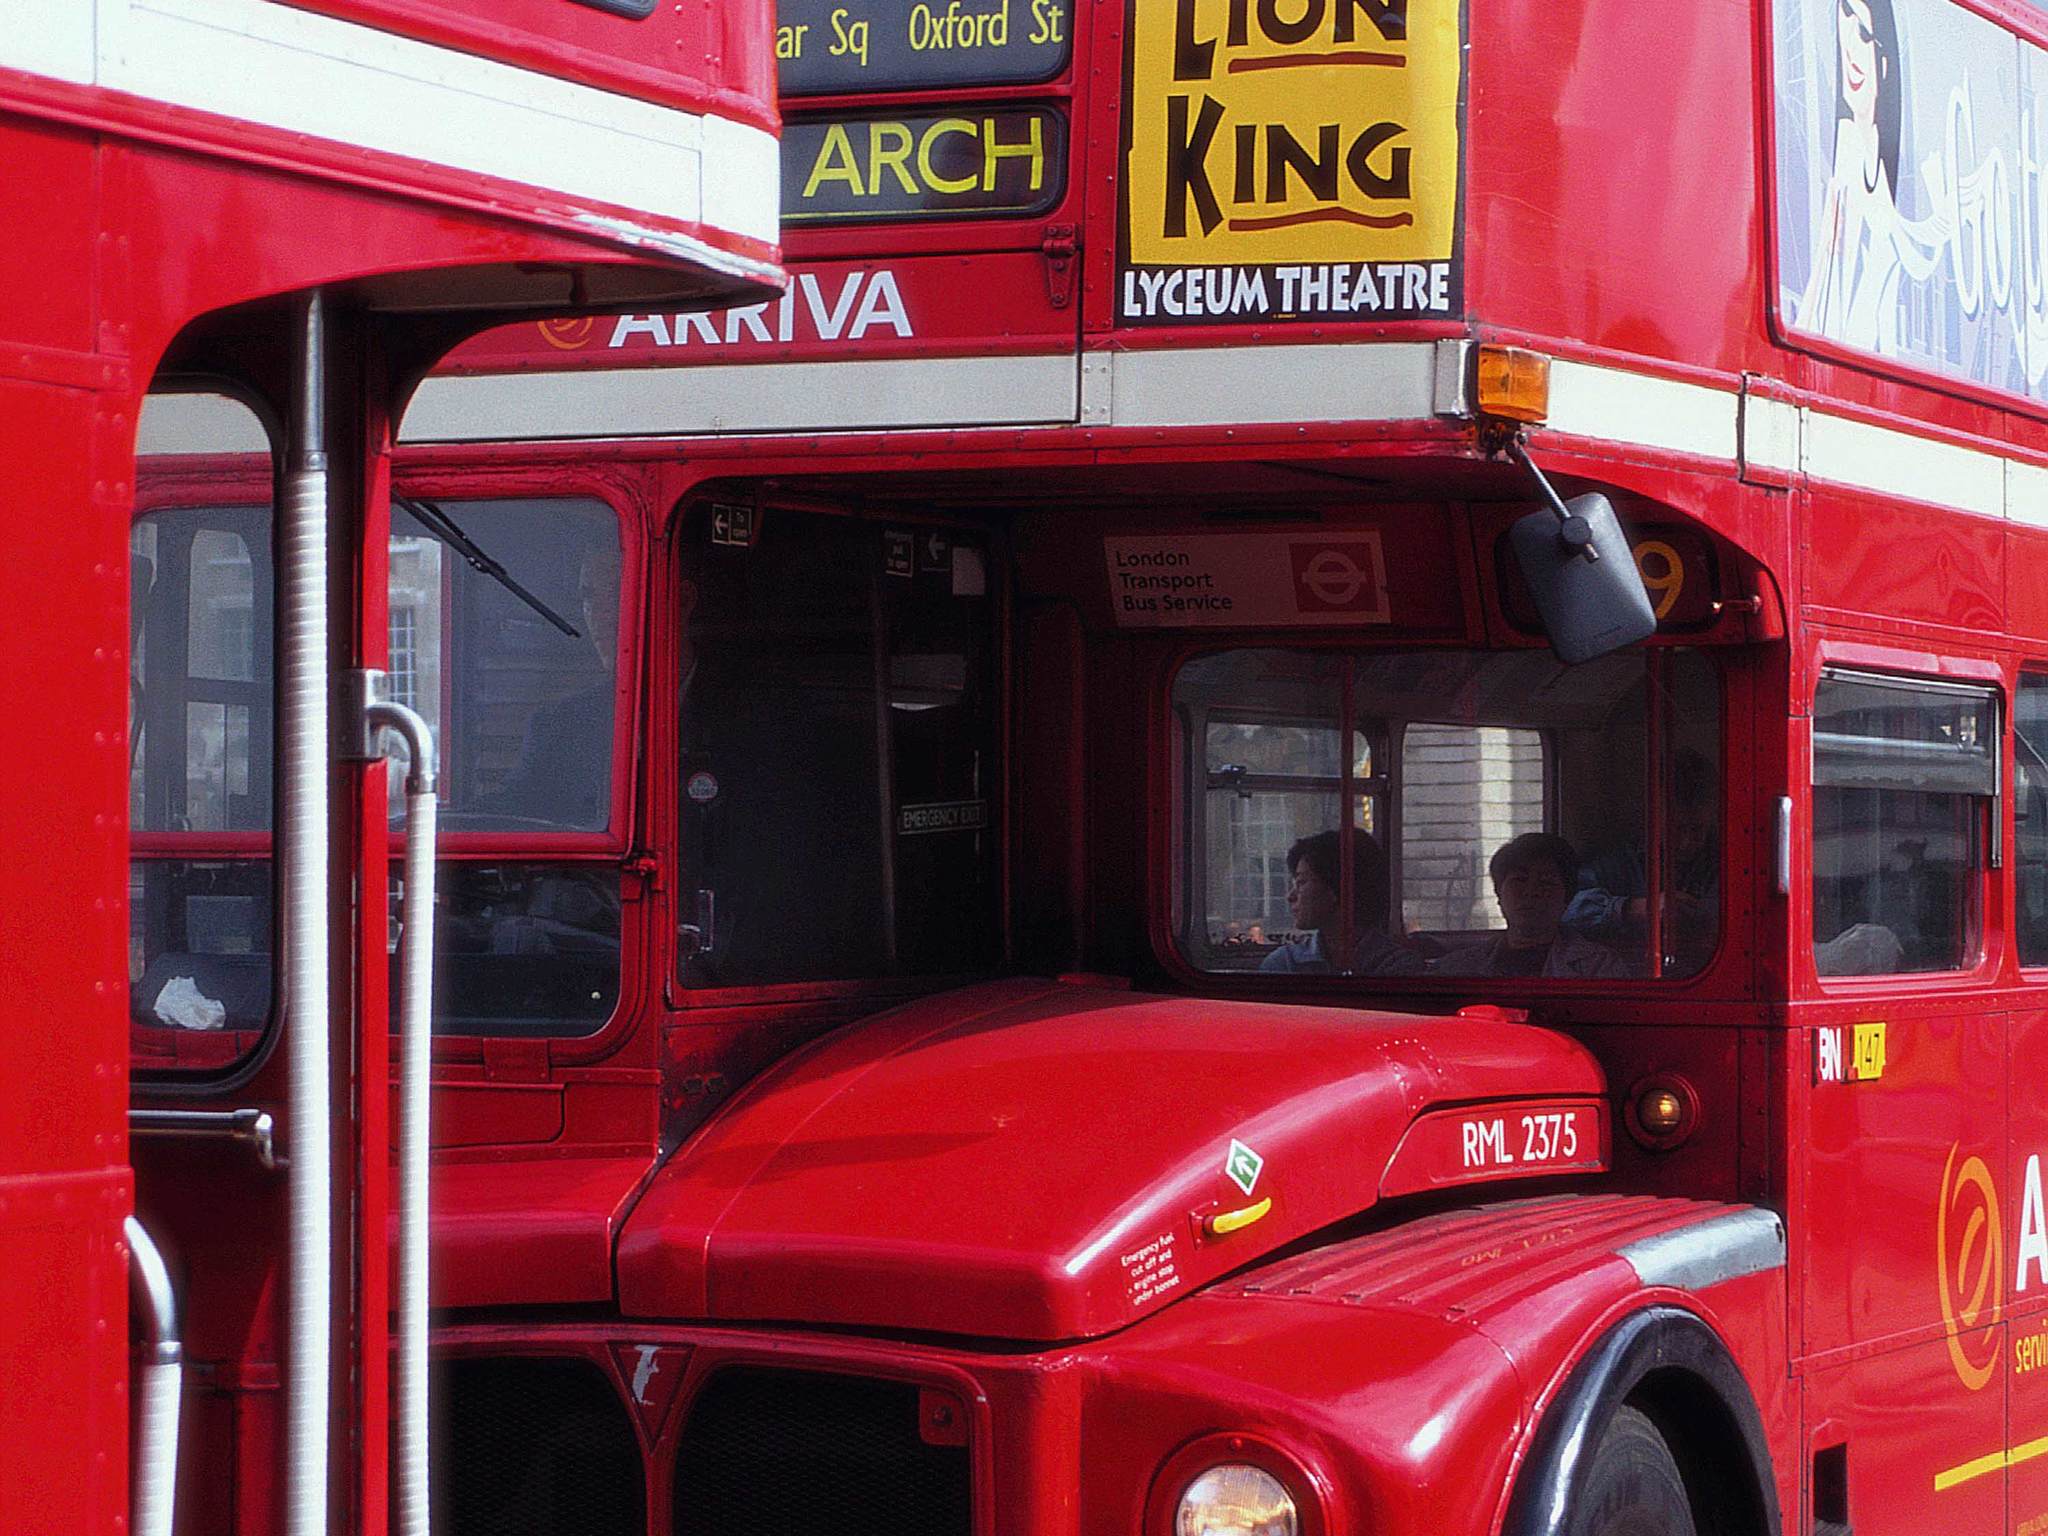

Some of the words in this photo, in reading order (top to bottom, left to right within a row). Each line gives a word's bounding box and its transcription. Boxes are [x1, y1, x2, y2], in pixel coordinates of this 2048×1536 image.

[829, 9, 869, 66] Sq
[909, 0, 1008, 50] Oxford
[1029, 0, 1064, 44] St
[1173, 0, 1408, 82] LION
[802, 117, 1043, 197] ARCH
[1163, 94, 1412, 238] KING
[1123, 265, 1269, 317] LYCEUM
[1275, 263, 1449, 313] THEATRE
[1115, 550, 1190, 567] London
[1118, 572, 1214, 591] Transport
[1633, 540, 1684, 620] 9
[1122, 595, 1157, 611] Bus
[1163, 593, 1233, 611] Service
[903, 807, 958, 829] EMERGENCY
[1819, 1027, 1841, 1080] BN
[1462, 1119, 1513, 1167] RML
[1521, 1112, 1577, 1161] 2375
[1121, 1241, 1159, 1267] Emergency
[1131, 1265, 1144, 1277] cut
[1145, 1255, 1156, 1270] off
[1159, 1248, 1172, 1263] and
[1133, 1273, 1157, 1290] engine
[1158, 1264, 1174, 1278] stop
[1133, 1289, 1153, 1306] under
[1154, 1275, 1180, 1295] bonnet
